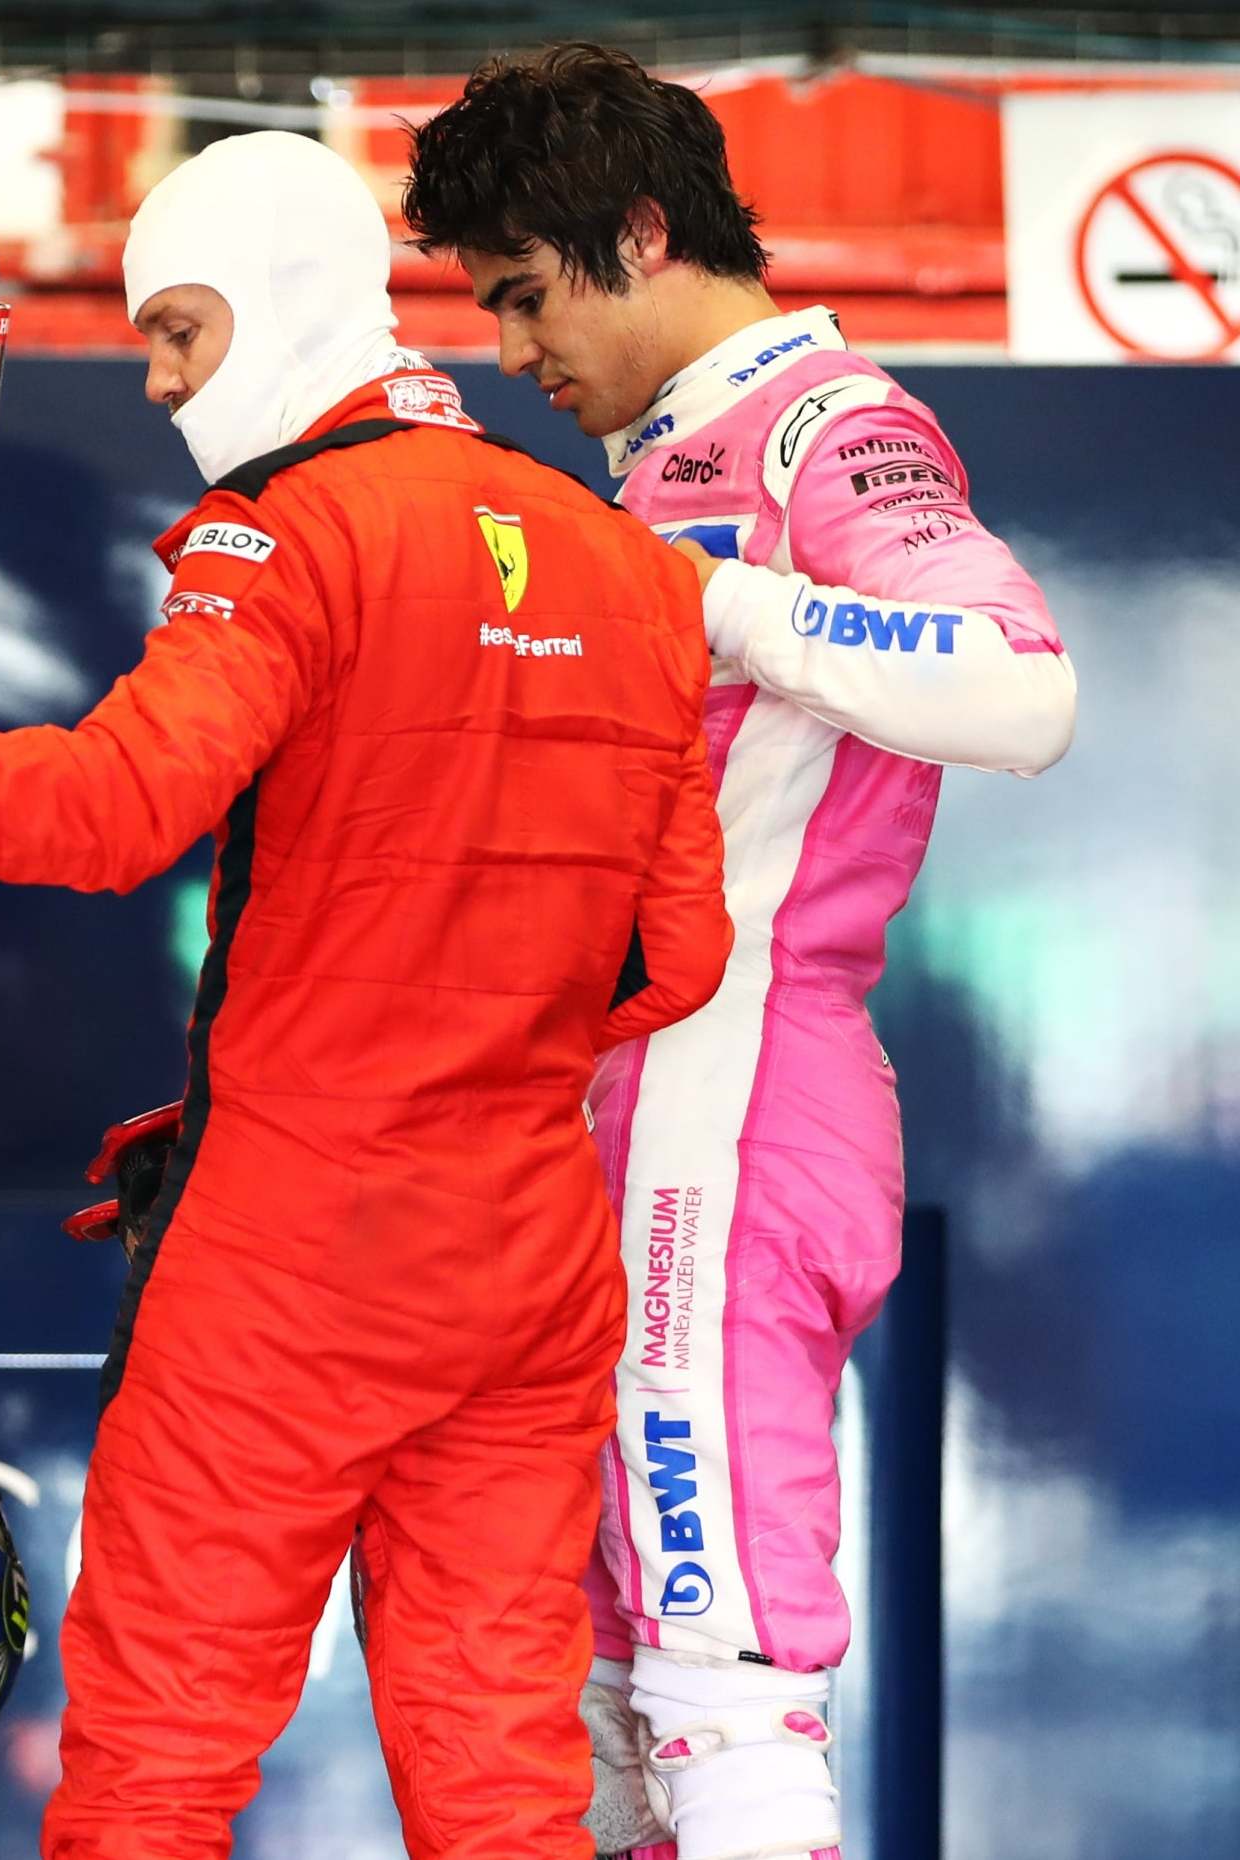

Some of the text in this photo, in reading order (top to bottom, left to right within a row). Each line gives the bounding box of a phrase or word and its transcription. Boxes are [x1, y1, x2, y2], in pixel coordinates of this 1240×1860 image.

[662, 453, 715, 484] Claro
[188, 528, 271, 554] UBLOT
[828, 602, 962, 653] BWT
[640, 1188, 680, 1368] MAGNESIUM
[673, 1185, 704, 1370] MINERALIZED WATER
[644, 1411, 705, 1553] BWT
